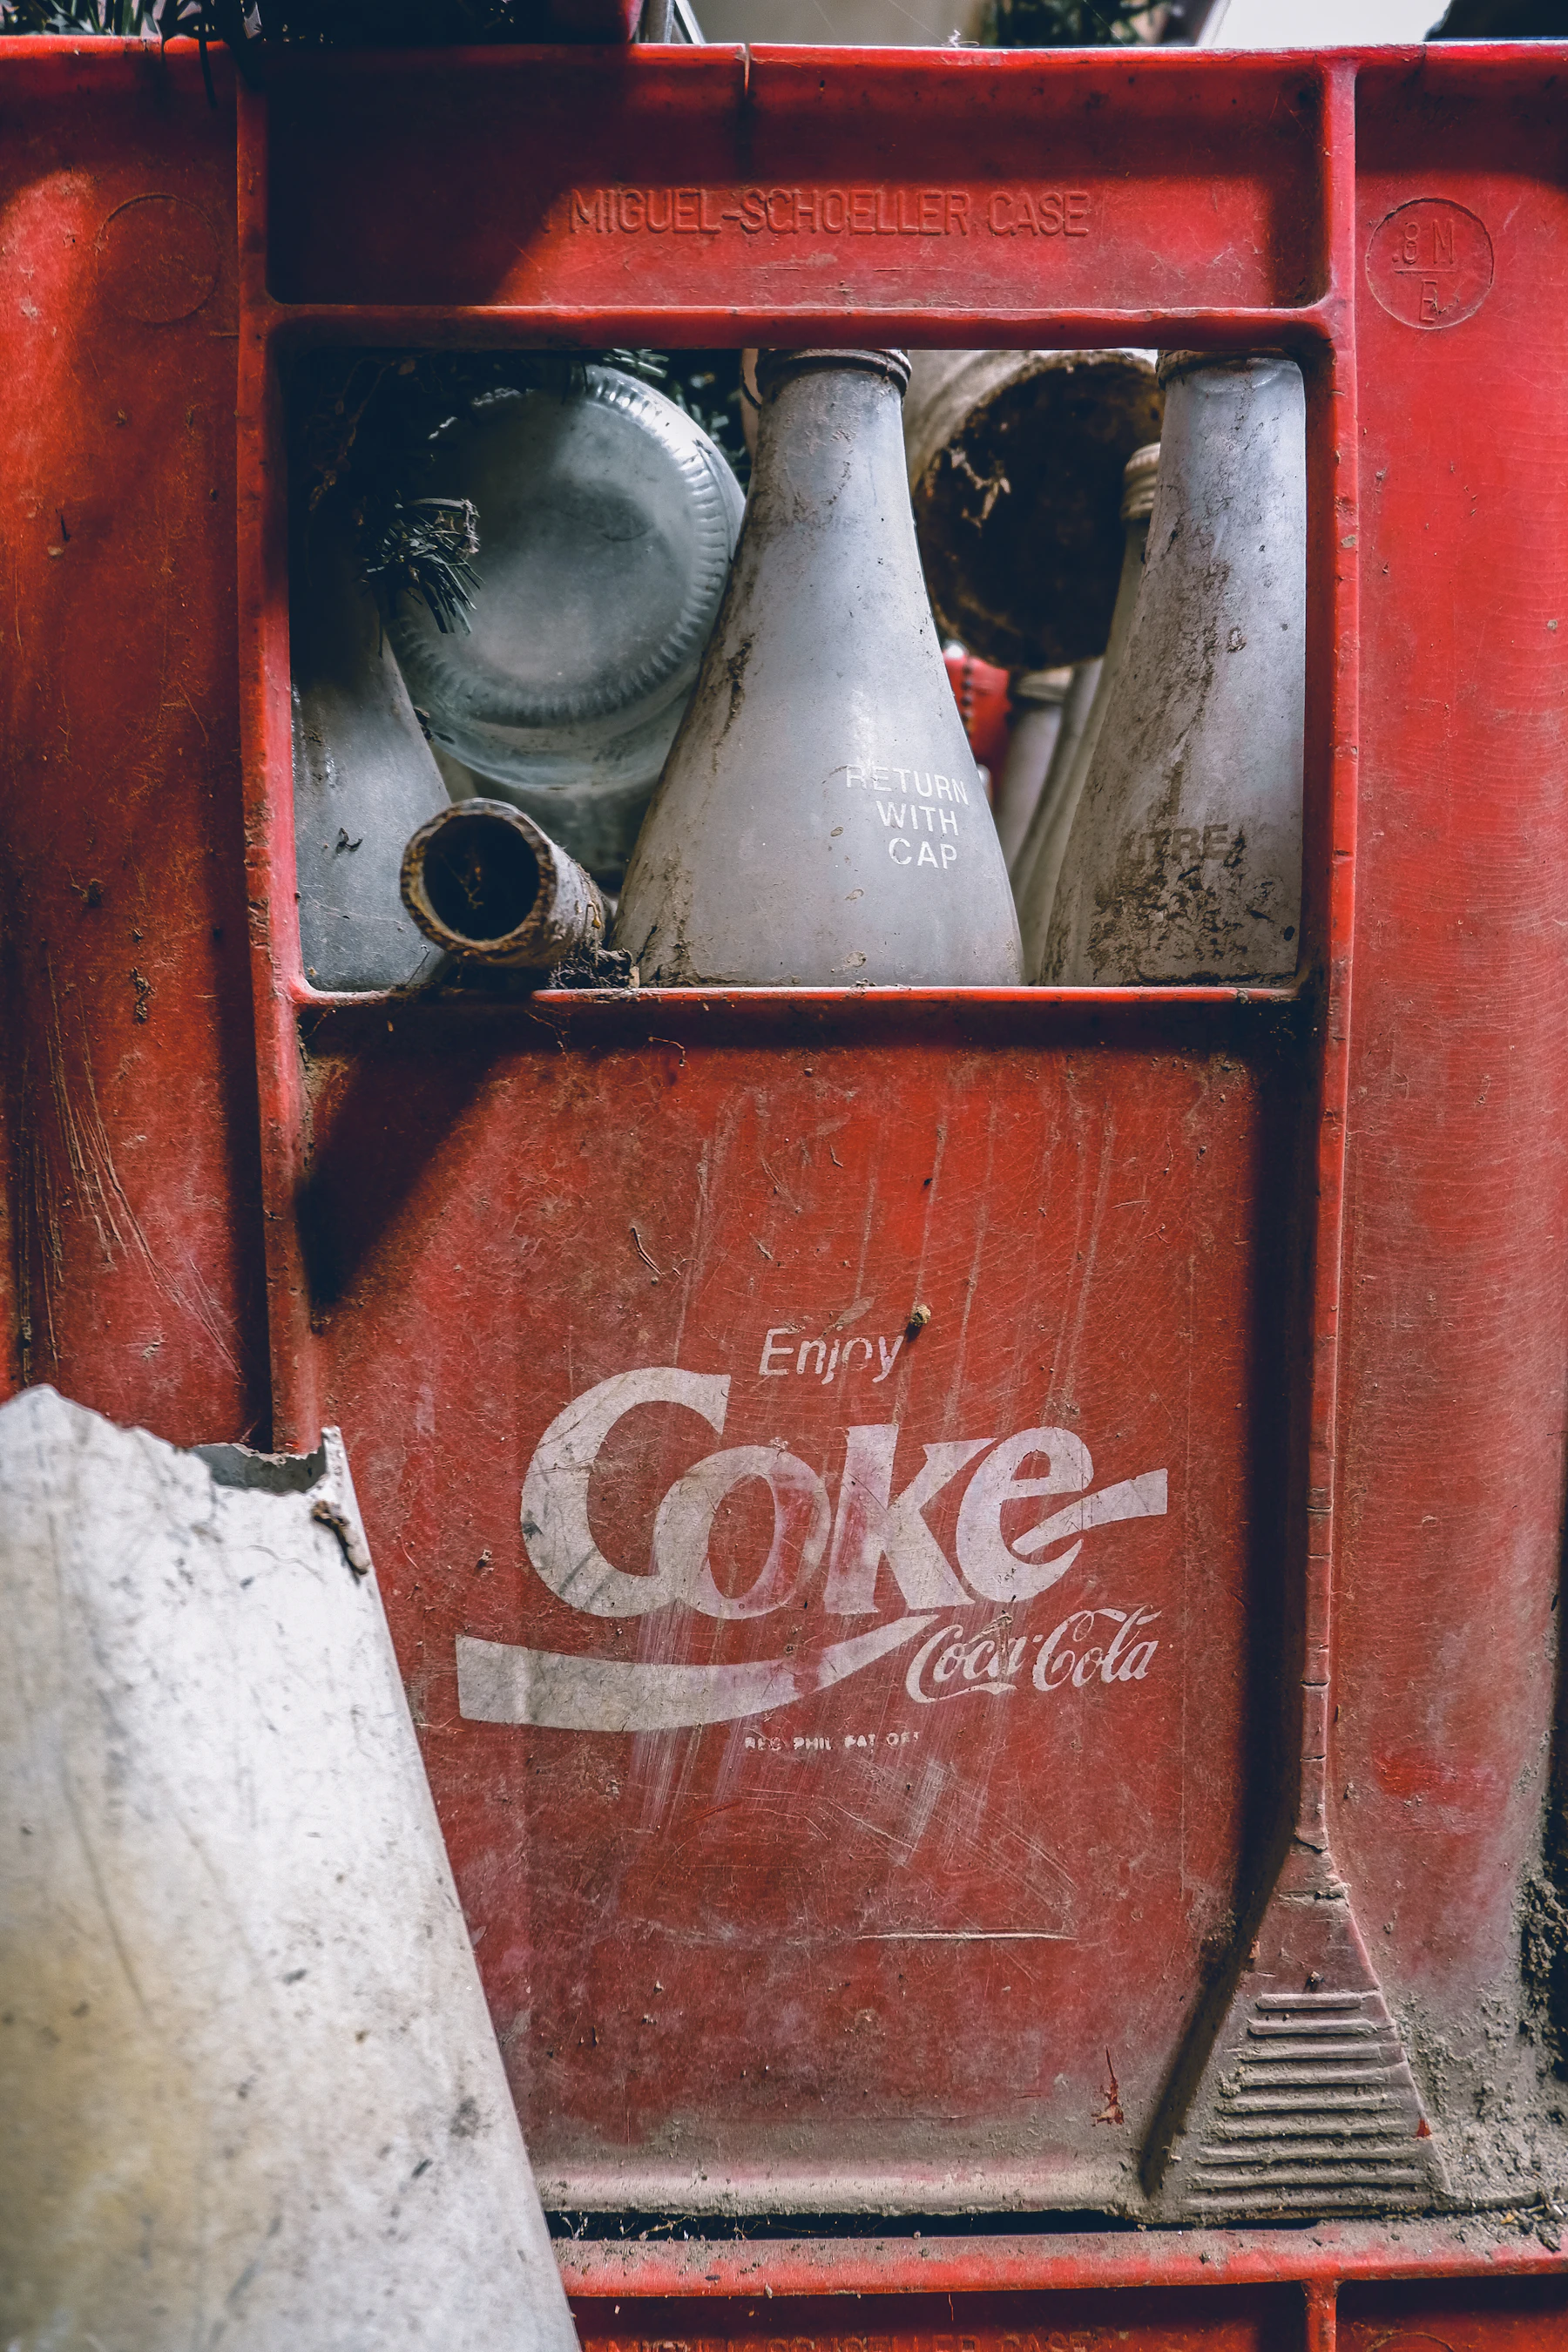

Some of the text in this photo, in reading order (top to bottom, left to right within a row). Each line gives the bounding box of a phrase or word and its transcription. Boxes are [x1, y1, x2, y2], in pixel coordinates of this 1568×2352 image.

[568, 187, 970, 235] MIGUEL-SCHOELLER
[987, 190, 1089, 237] CASE
[846, 763, 969, 805] RETURN
[875, 801, 959, 836] WITH
[889, 837, 957, 869] CAP
[758, 1326, 905, 1385] Enjoy
[520, 1366, 1168, 1619] Coke
[905, 1605, 1163, 1704] Coca-Cola
